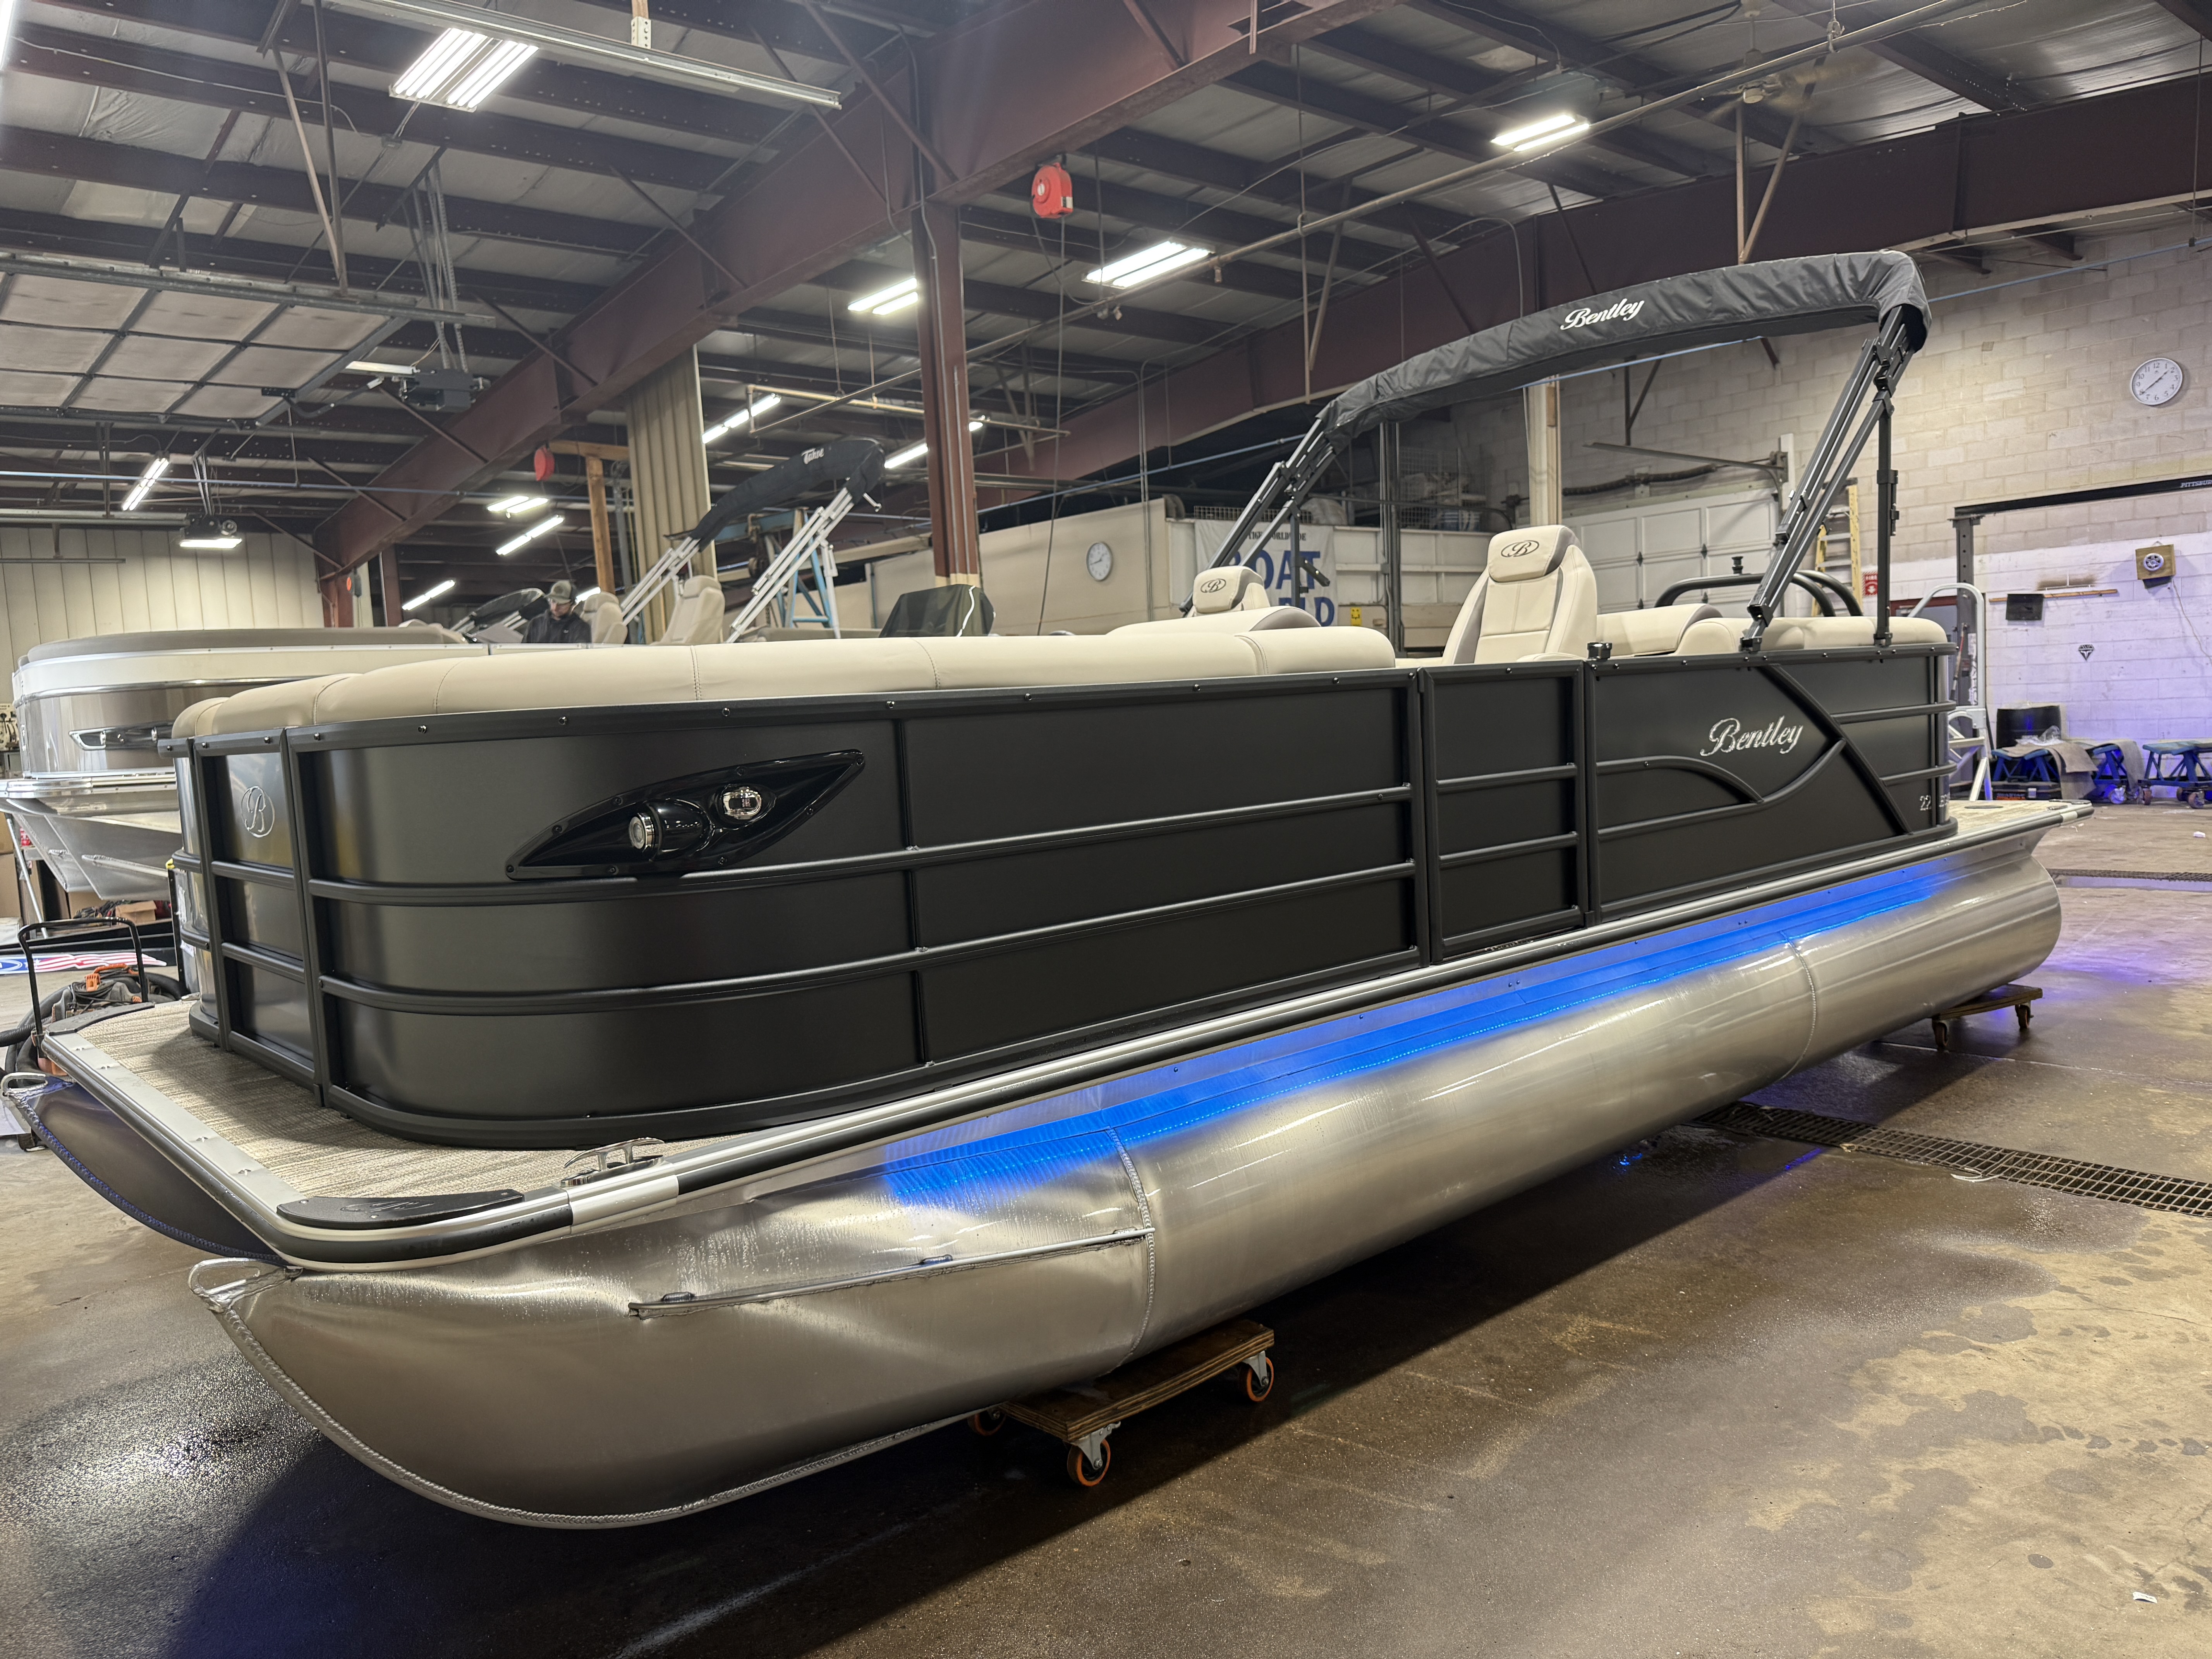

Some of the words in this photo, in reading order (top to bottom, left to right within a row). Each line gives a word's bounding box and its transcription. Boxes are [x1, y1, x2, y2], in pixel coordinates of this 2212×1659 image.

[1560, 298, 1645, 330] Bentley
[801, 448, 824, 464] Tahoe
[1229, 550, 1320, 590] OAT
[1700, 715, 1803, 756] Bentley
[1920, 795, 1932, 811] 22
